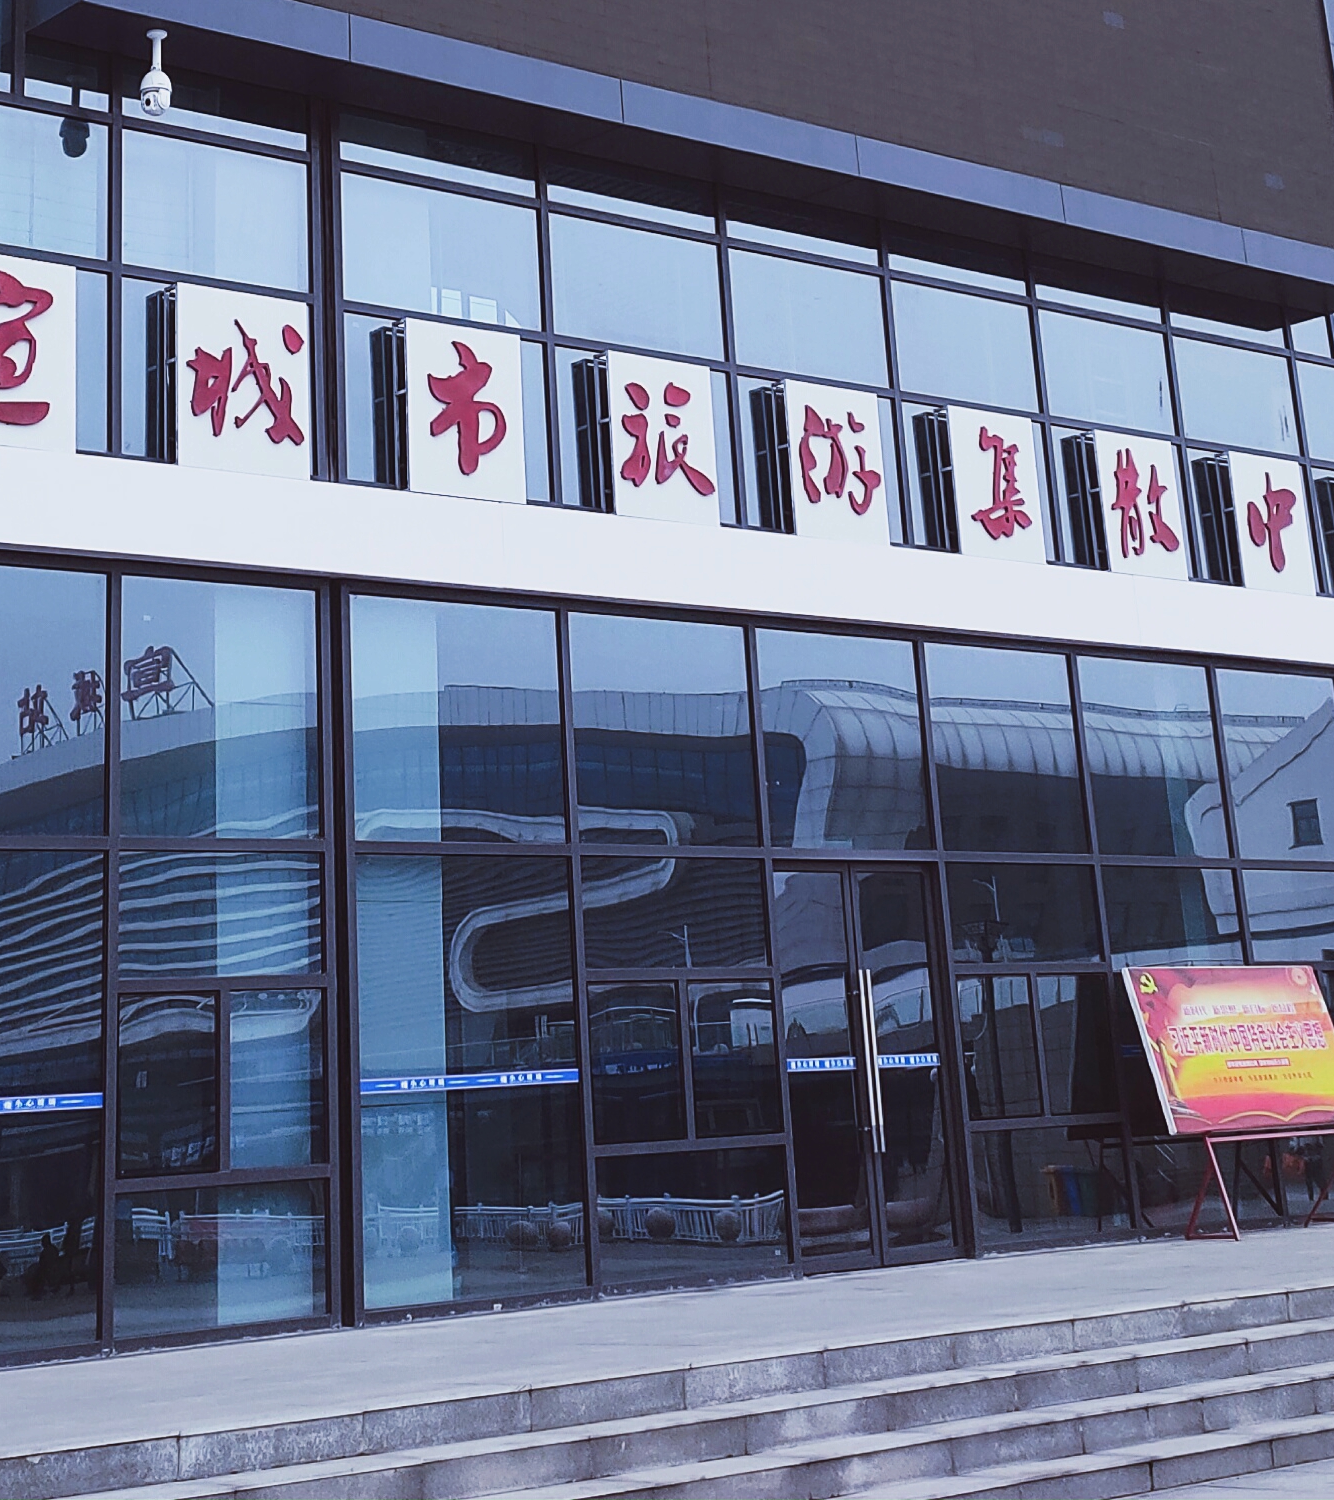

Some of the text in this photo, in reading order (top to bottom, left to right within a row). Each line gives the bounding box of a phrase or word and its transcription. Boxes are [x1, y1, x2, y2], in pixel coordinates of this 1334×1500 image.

[1168, 1021, 1329, 1055] 习近平新时代中国特色社会主义思想
